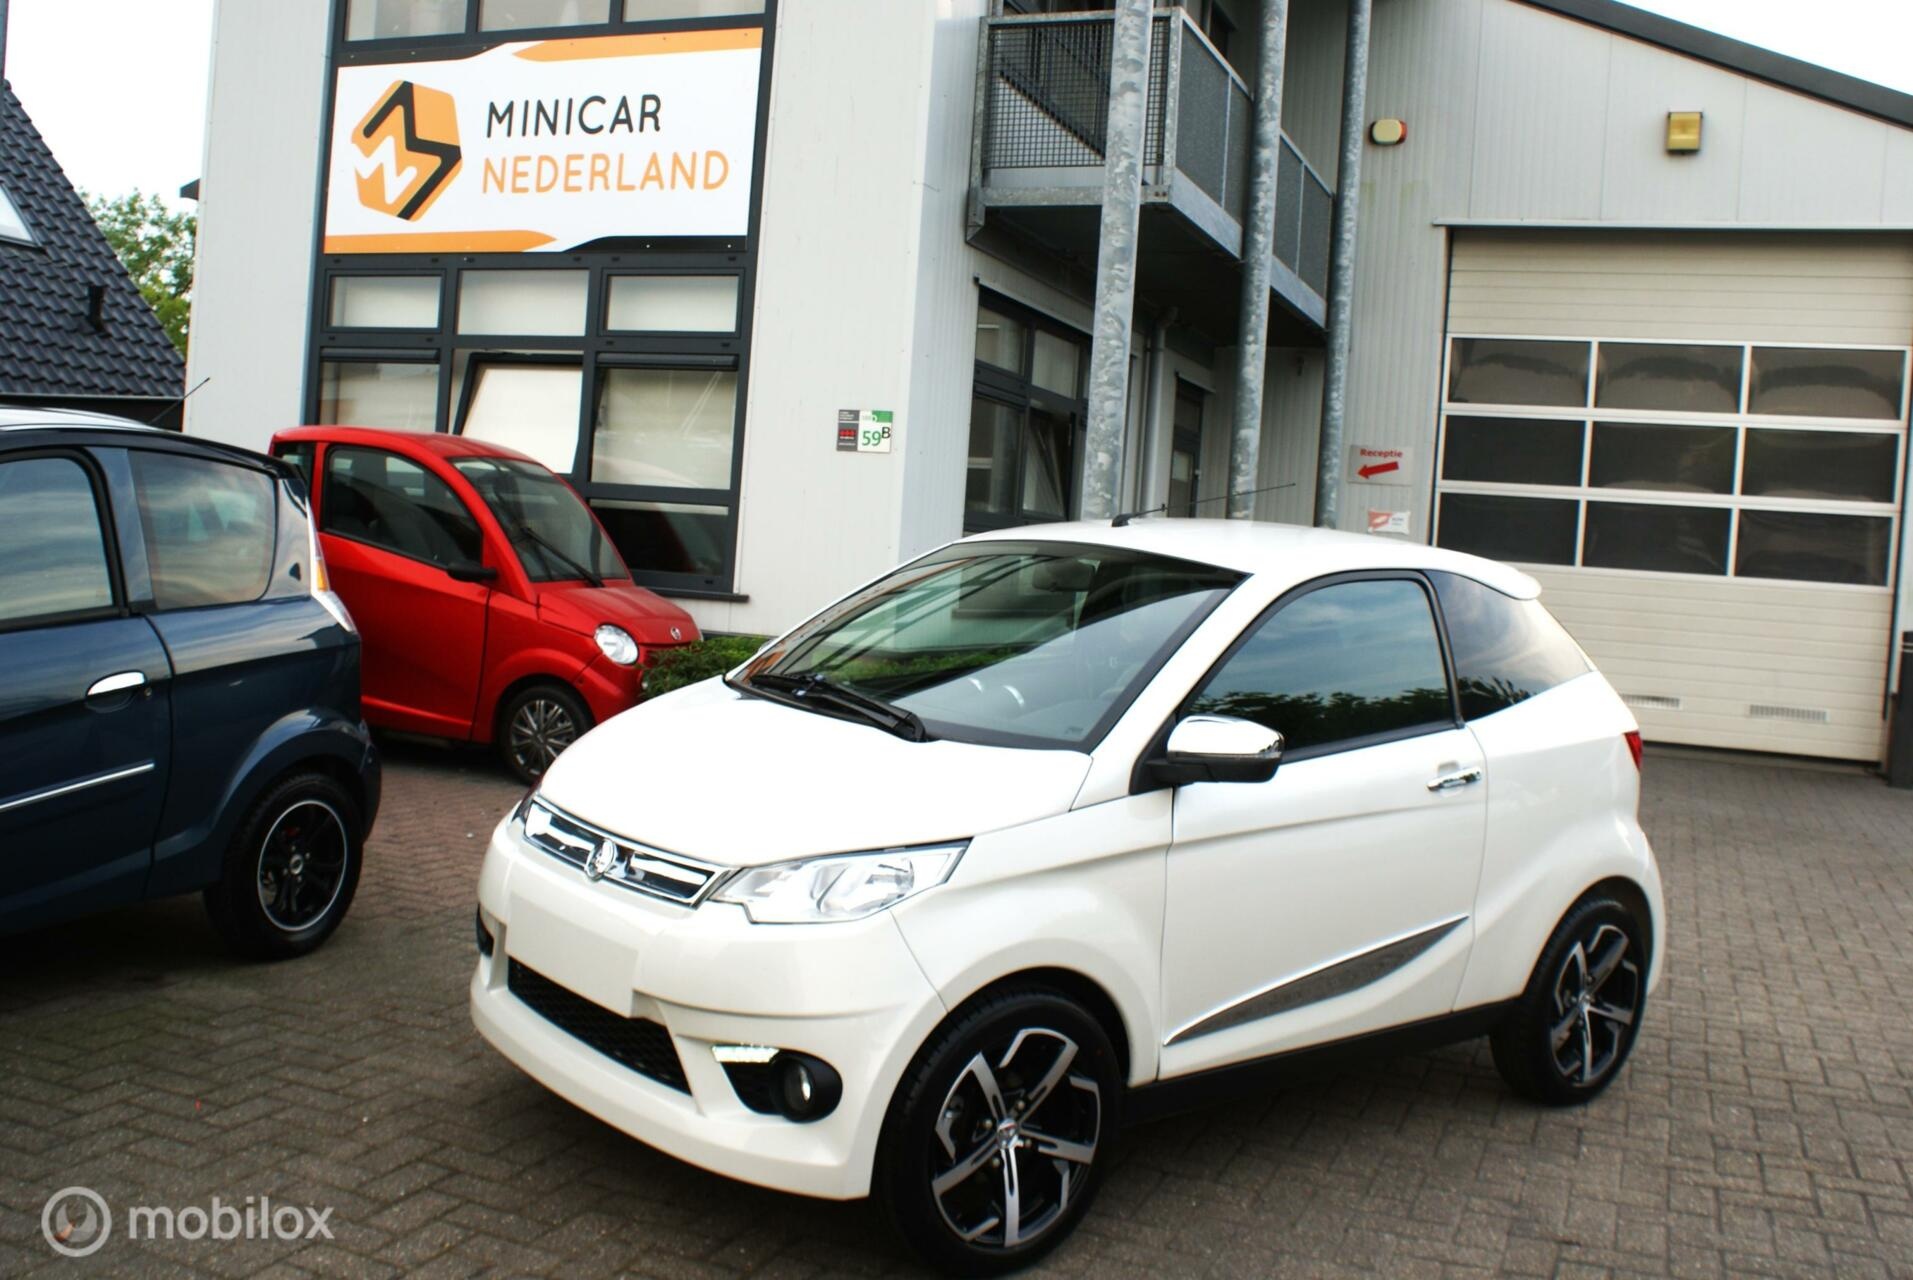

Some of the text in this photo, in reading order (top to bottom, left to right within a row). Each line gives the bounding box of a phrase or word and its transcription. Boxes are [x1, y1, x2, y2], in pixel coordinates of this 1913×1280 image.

[486, 94, 661, 138] MINICAR
[482, 150, 730, 194] NEDERLAND
[1360, 449, 1403, 458] Receptie
